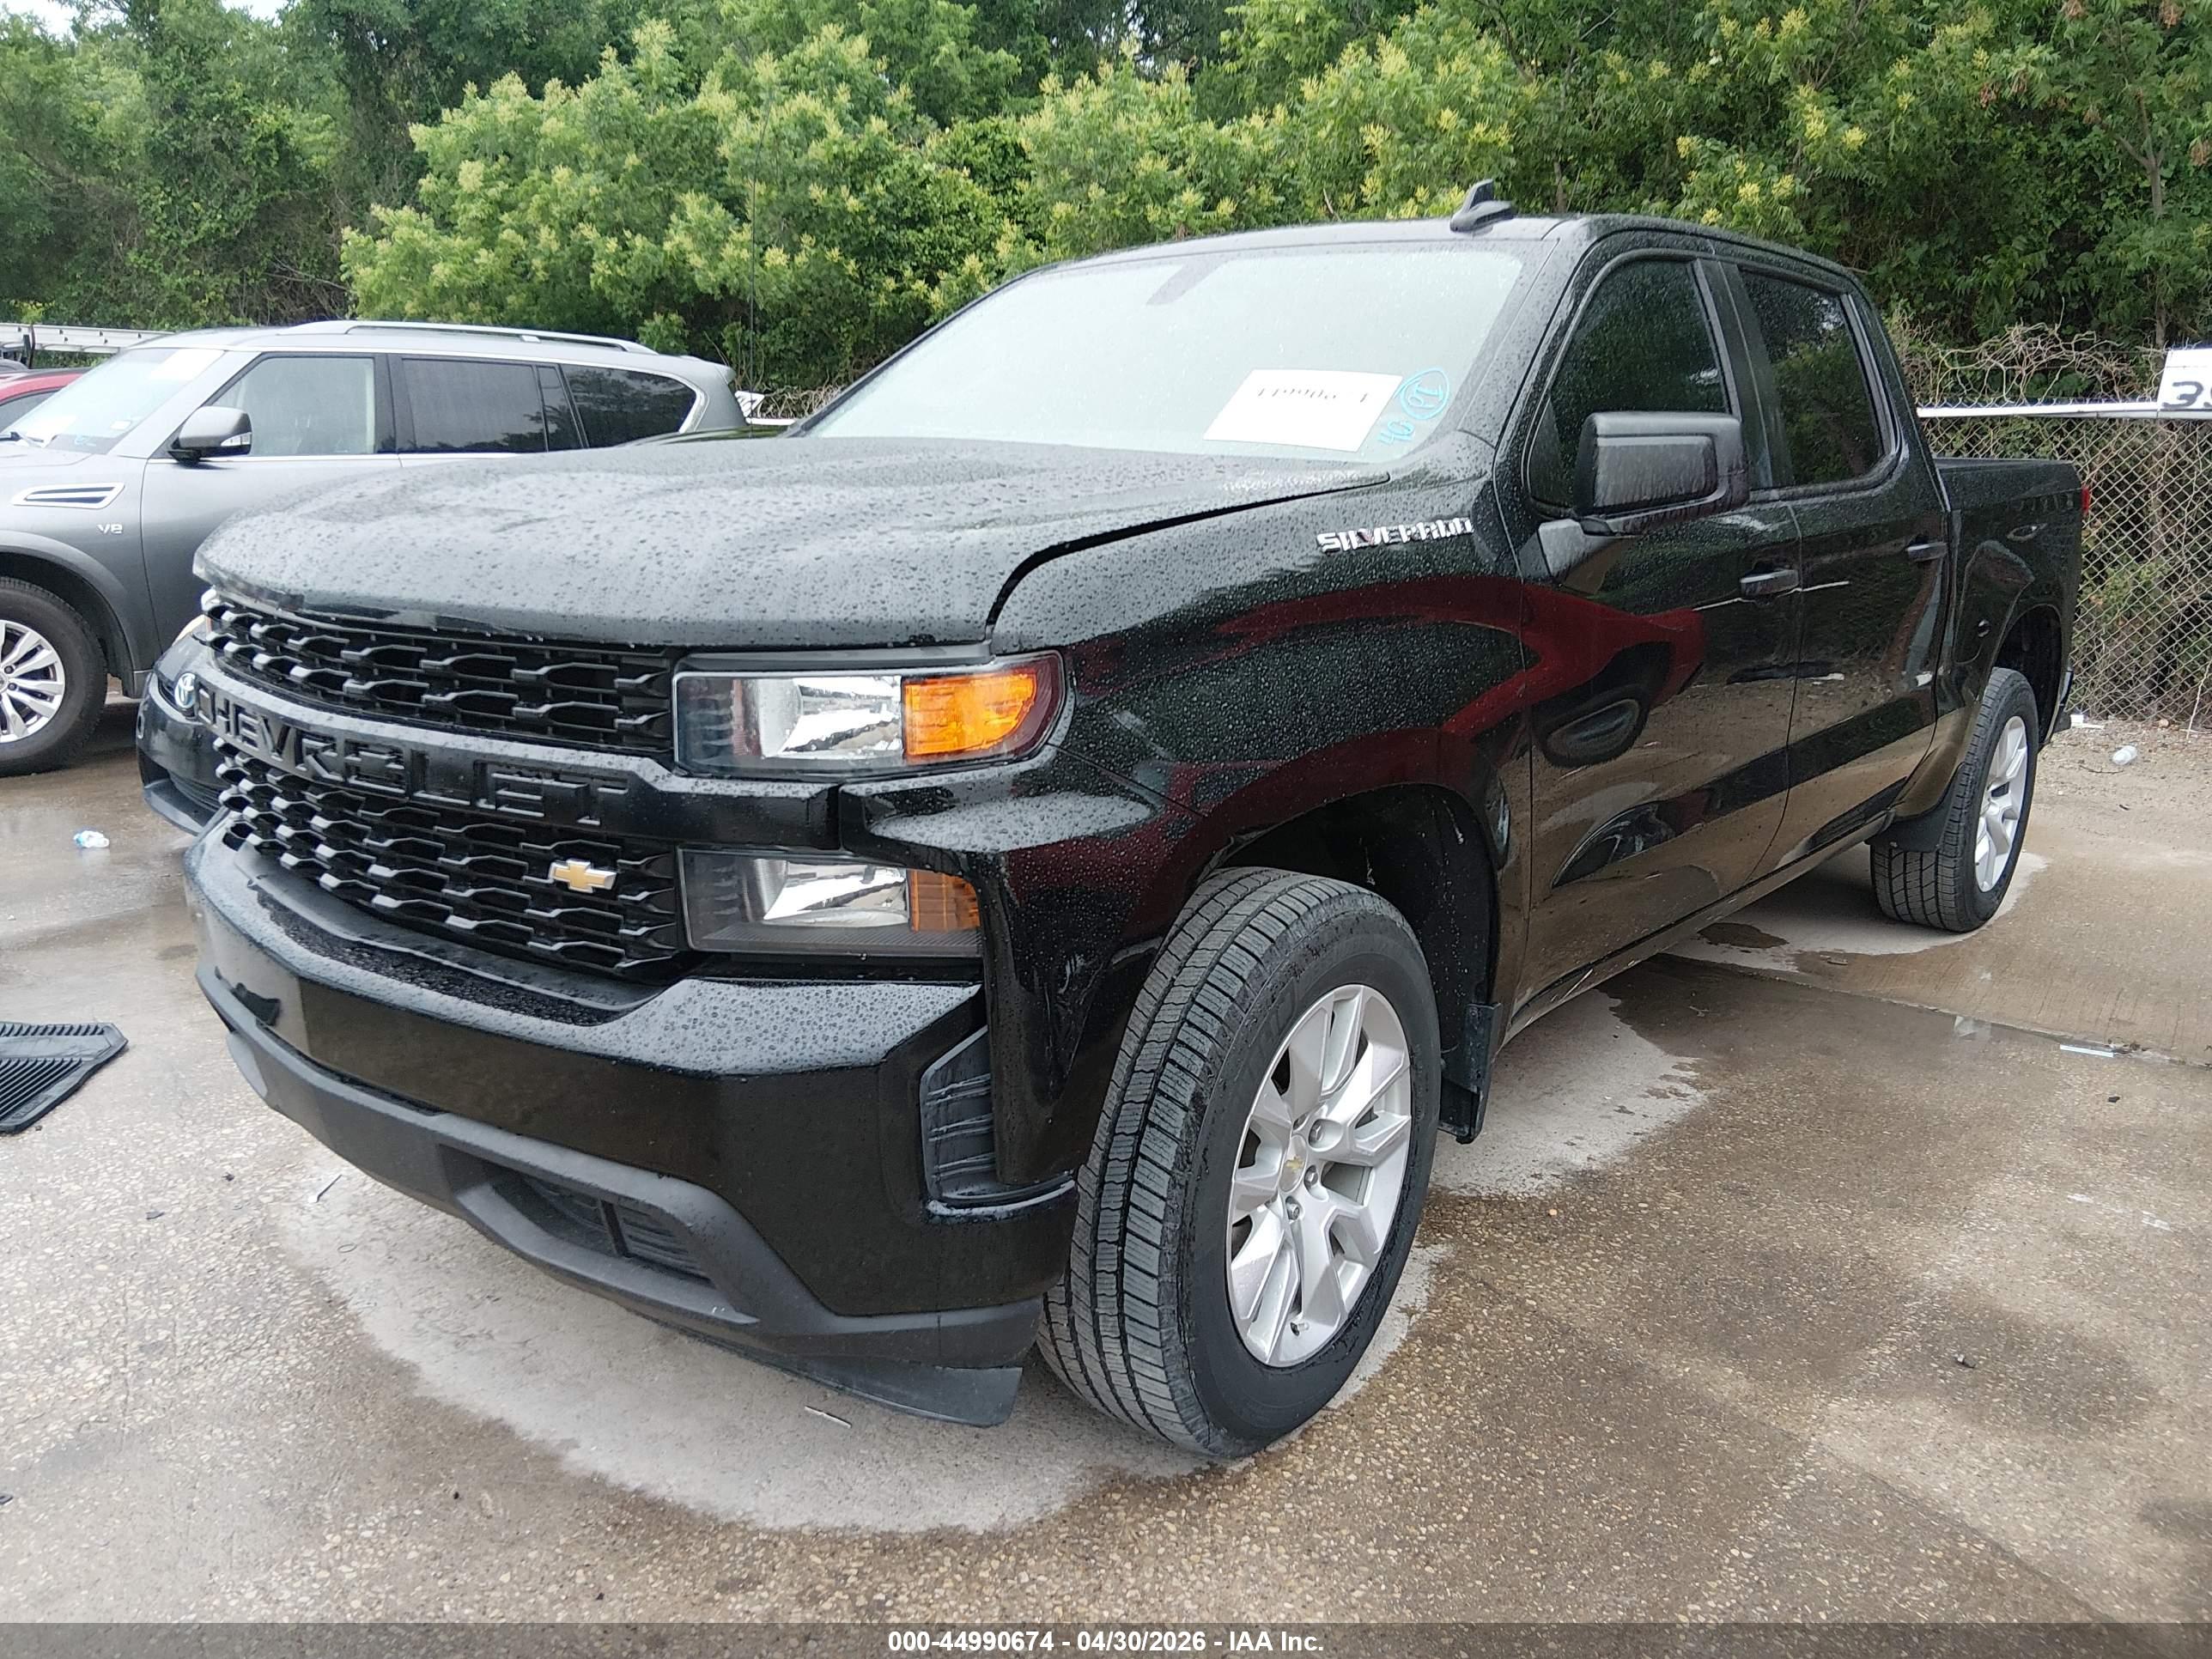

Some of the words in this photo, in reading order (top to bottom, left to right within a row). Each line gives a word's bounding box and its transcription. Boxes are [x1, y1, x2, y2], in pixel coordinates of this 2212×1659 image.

[2162, 381, 2212, 409] 3
[97, 523, 123, 535] V8
[1317, 519, 1474, 553] SILVERADO
[198, 688, 628, 826] CHEVROLET
